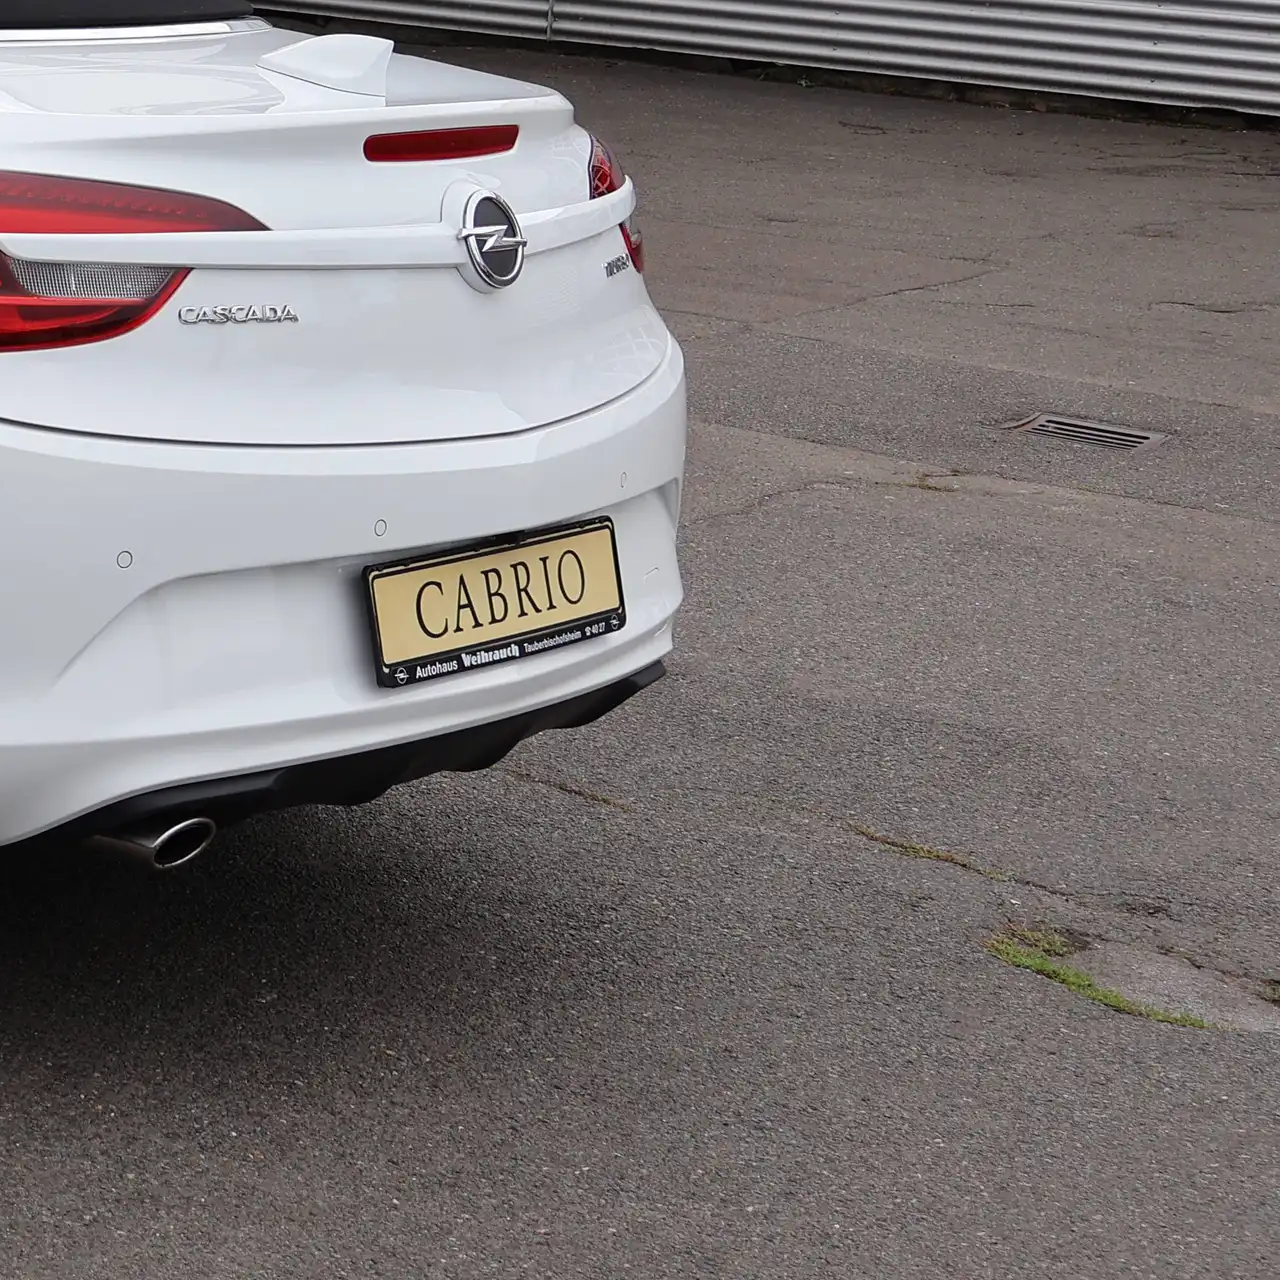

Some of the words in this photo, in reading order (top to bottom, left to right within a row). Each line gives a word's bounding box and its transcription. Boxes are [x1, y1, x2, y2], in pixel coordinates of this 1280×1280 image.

[178, 304, 300, 325] CASCADA
[415, 549, 585, 639] CABRIO
[415, 660, 458, 679] Autohaus
[461, 643, 520, 668] Weihrauch
[523, 629, 582, 652] Tauberbischofsheim
[591, 624, 599, 634] 40
[599, 622, 606, 632] 27
